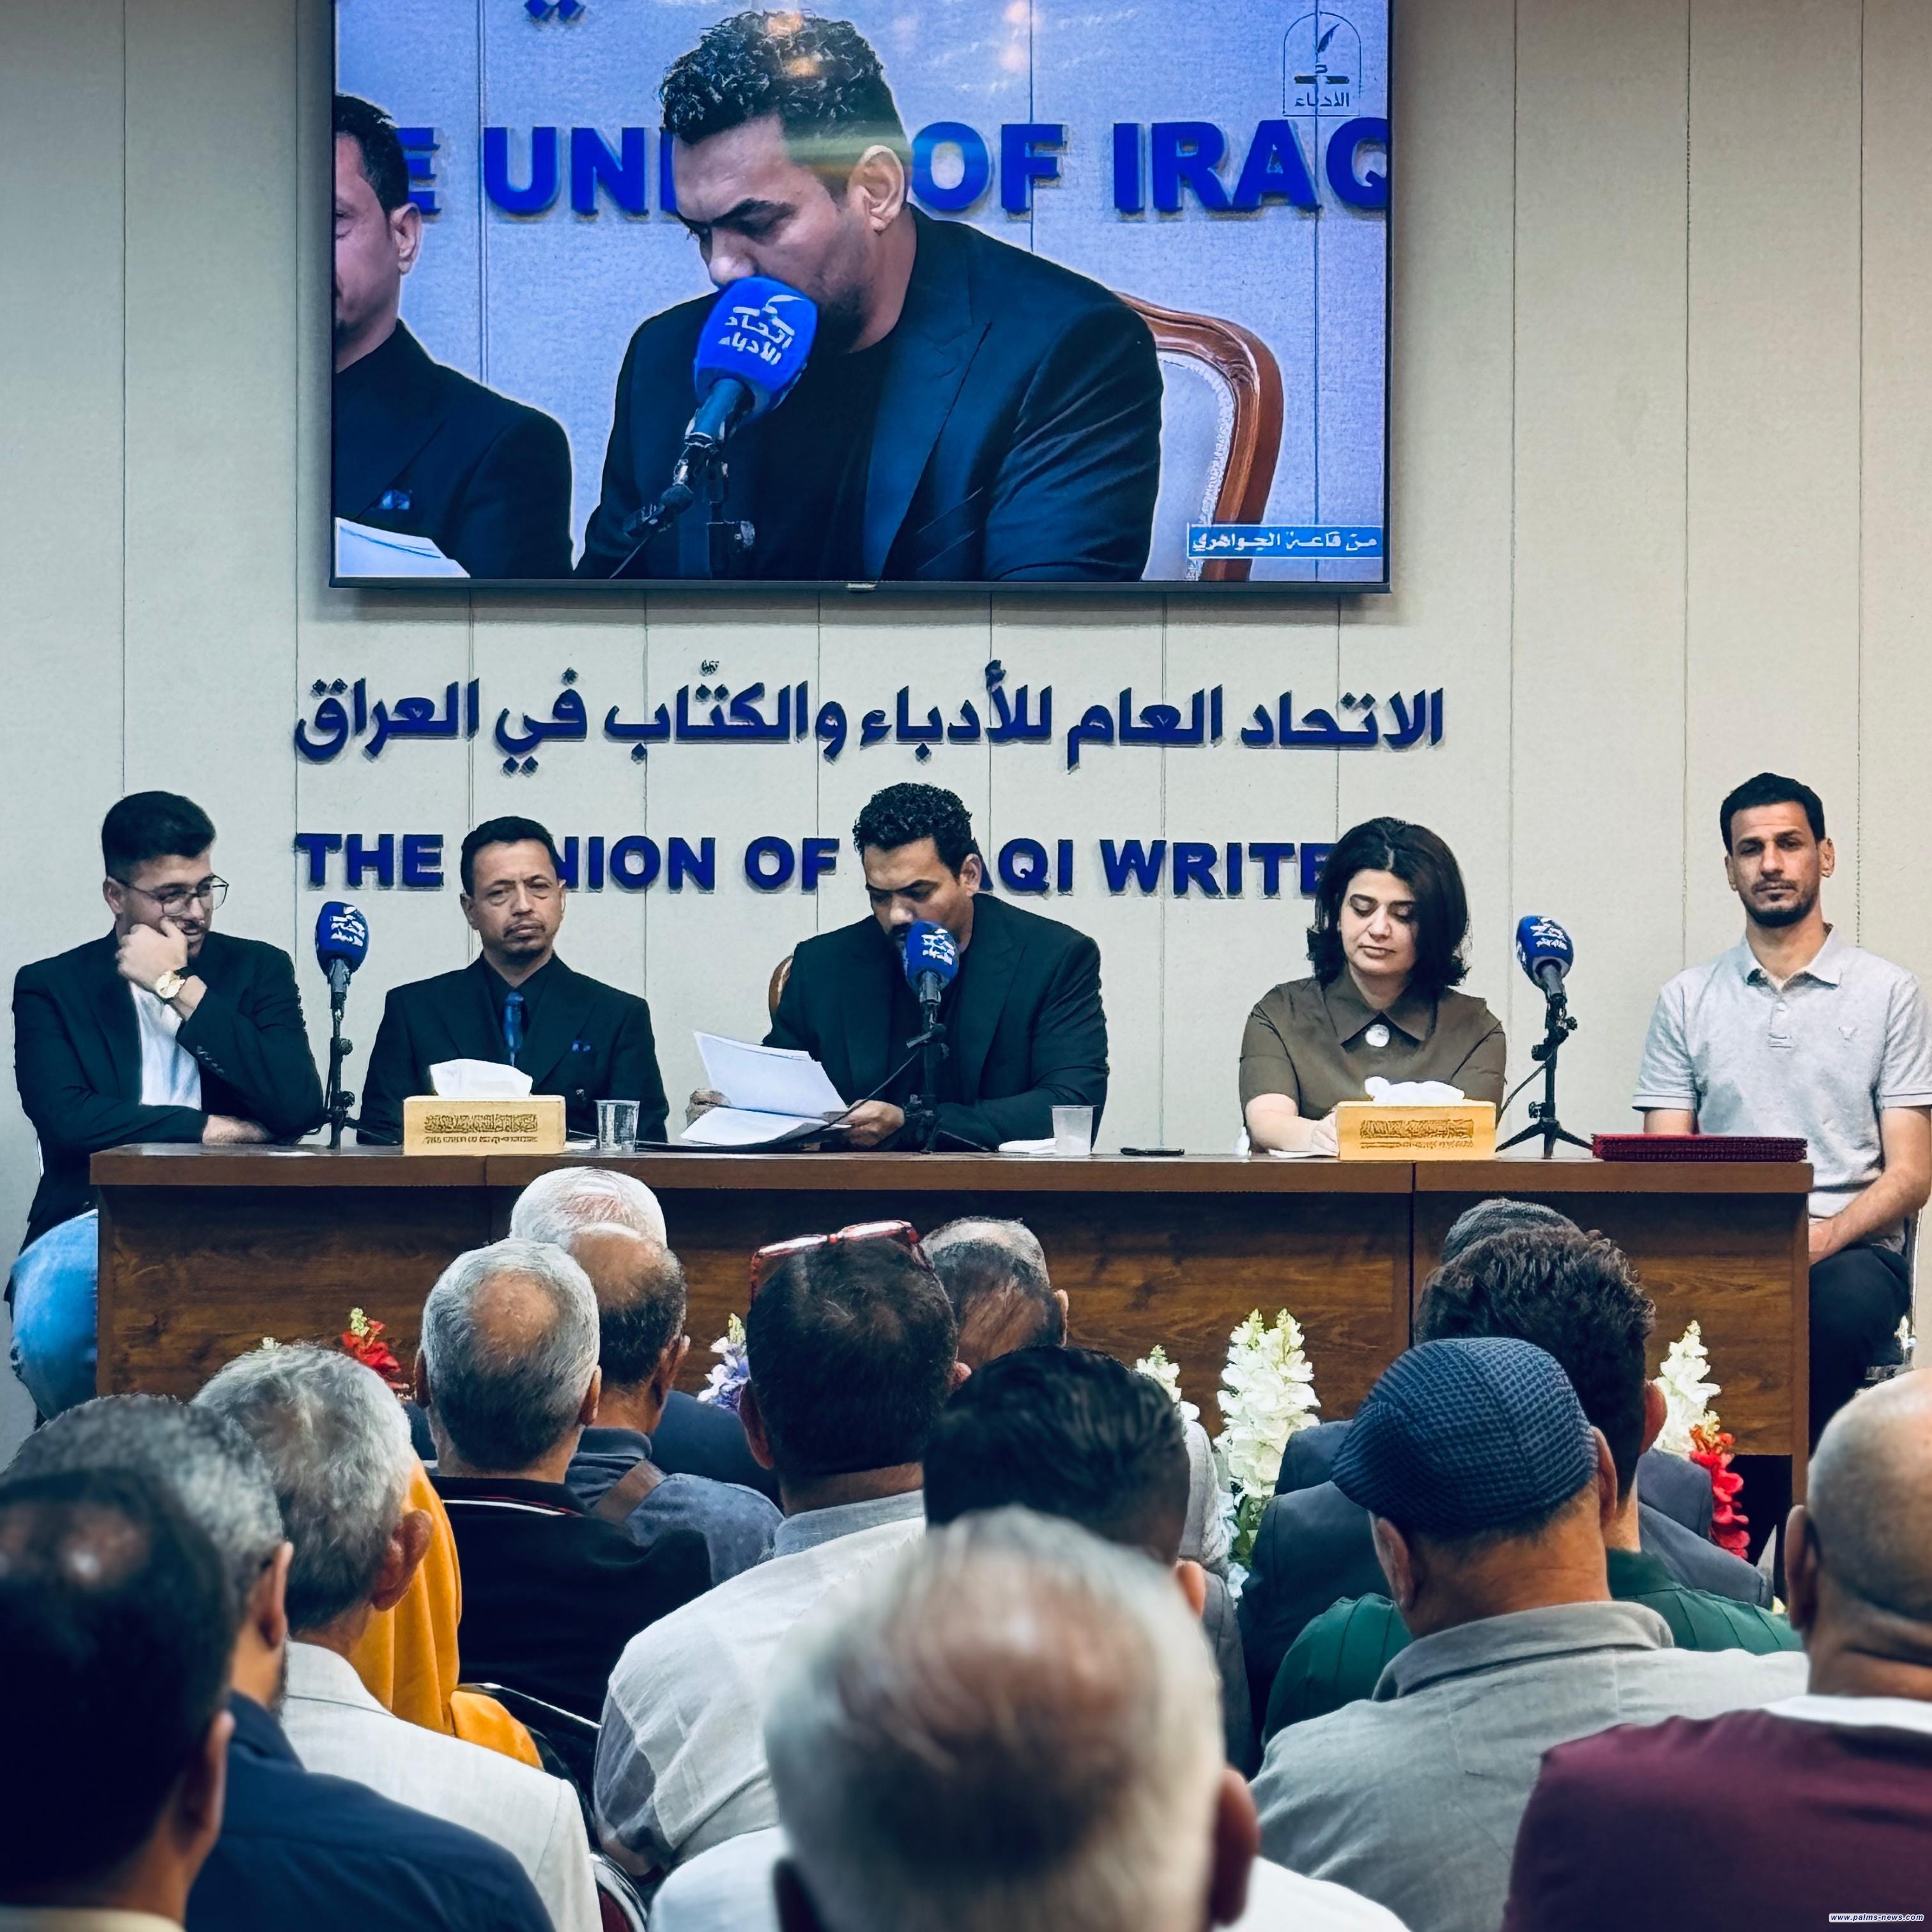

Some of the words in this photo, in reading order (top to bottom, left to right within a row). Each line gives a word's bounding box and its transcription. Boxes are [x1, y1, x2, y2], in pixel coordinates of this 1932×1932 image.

[484, 126, 682, 216] UNI
[911, 121, 1067, 212] OF
[1113, 118, 1388, 212] IRAQ
[1345, 533, 1379, 551] من
[295, 677, 480, 762] العراق
[494, 668, 588, 774] في
[860, 659, 1052, 763] للأدباء
[1068, 684, 1223, 771] العام
[1241, 686, 1444, 749] الاتحاد
[295, 833, 444, 890] THE
[744, 836, 839, 892] OF
[1100, 839, 1339, 896] WRITE
